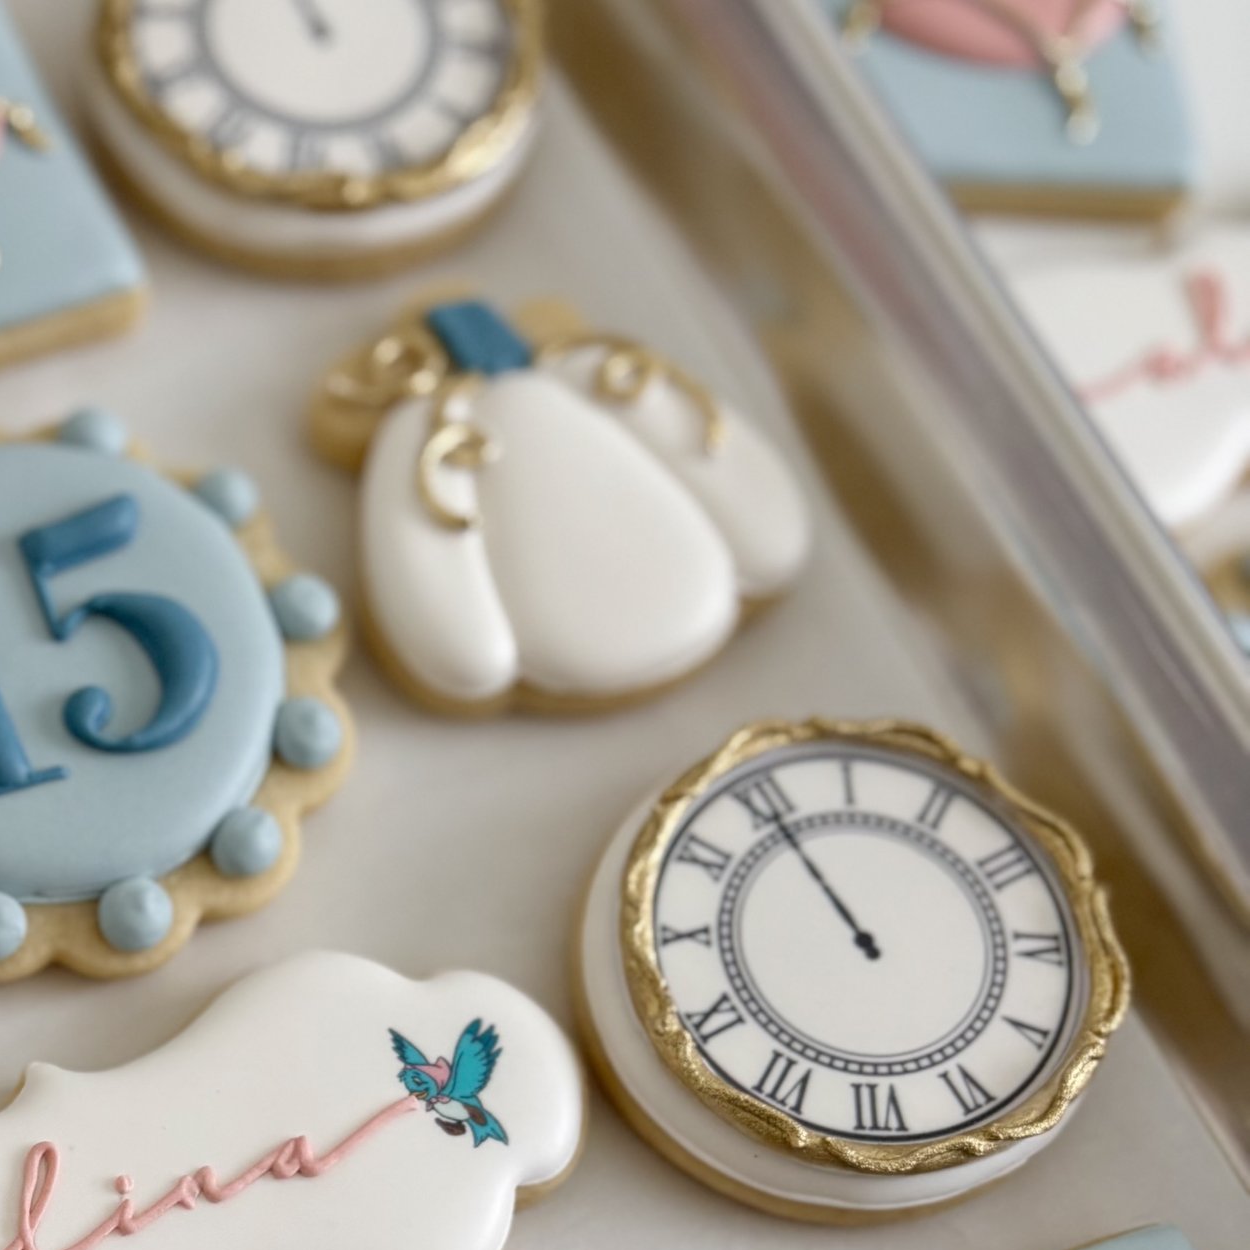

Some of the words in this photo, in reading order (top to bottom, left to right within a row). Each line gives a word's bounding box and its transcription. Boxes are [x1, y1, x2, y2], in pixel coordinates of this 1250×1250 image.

[915, 780, 958, 830] II
[673, 832, 733, 883] XI
[976, 841, 1039, 892] III
[660, 923, 712, 947] X
[1012, 929, 1065, 968] IV
[684, 991, 746, 1044] IX
[1001, 1016, 1051, 1051] V
[850, 1082, 910, 1133] VII
[937, 1063, 997, 1117] VI
